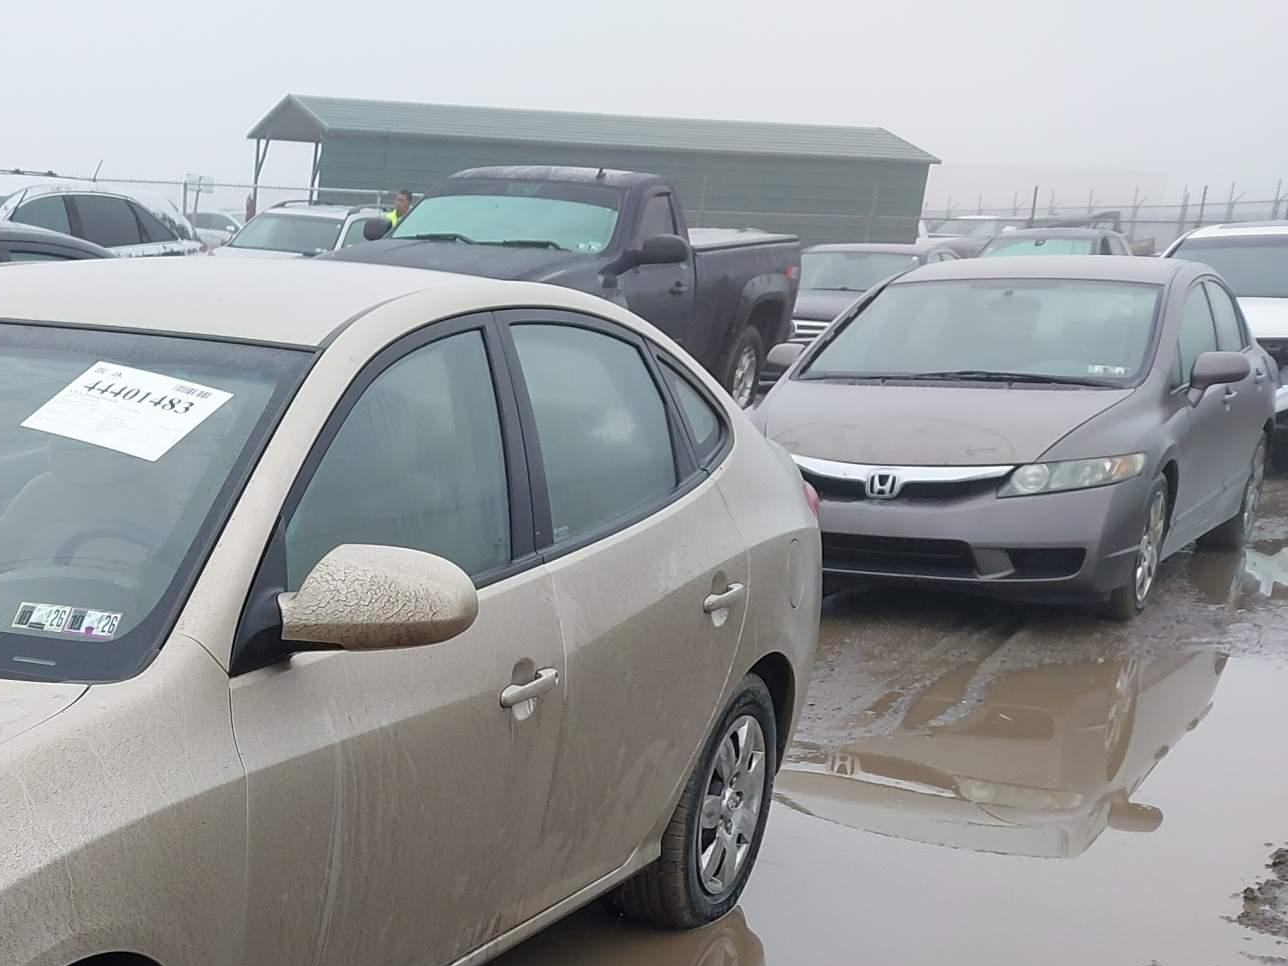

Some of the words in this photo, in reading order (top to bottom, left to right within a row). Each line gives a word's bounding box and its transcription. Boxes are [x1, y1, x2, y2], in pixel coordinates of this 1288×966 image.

[84, 380, 195, 414] 44401483
[50, 609, 66, 627] 26
[101, 615, 118, 634] 26
